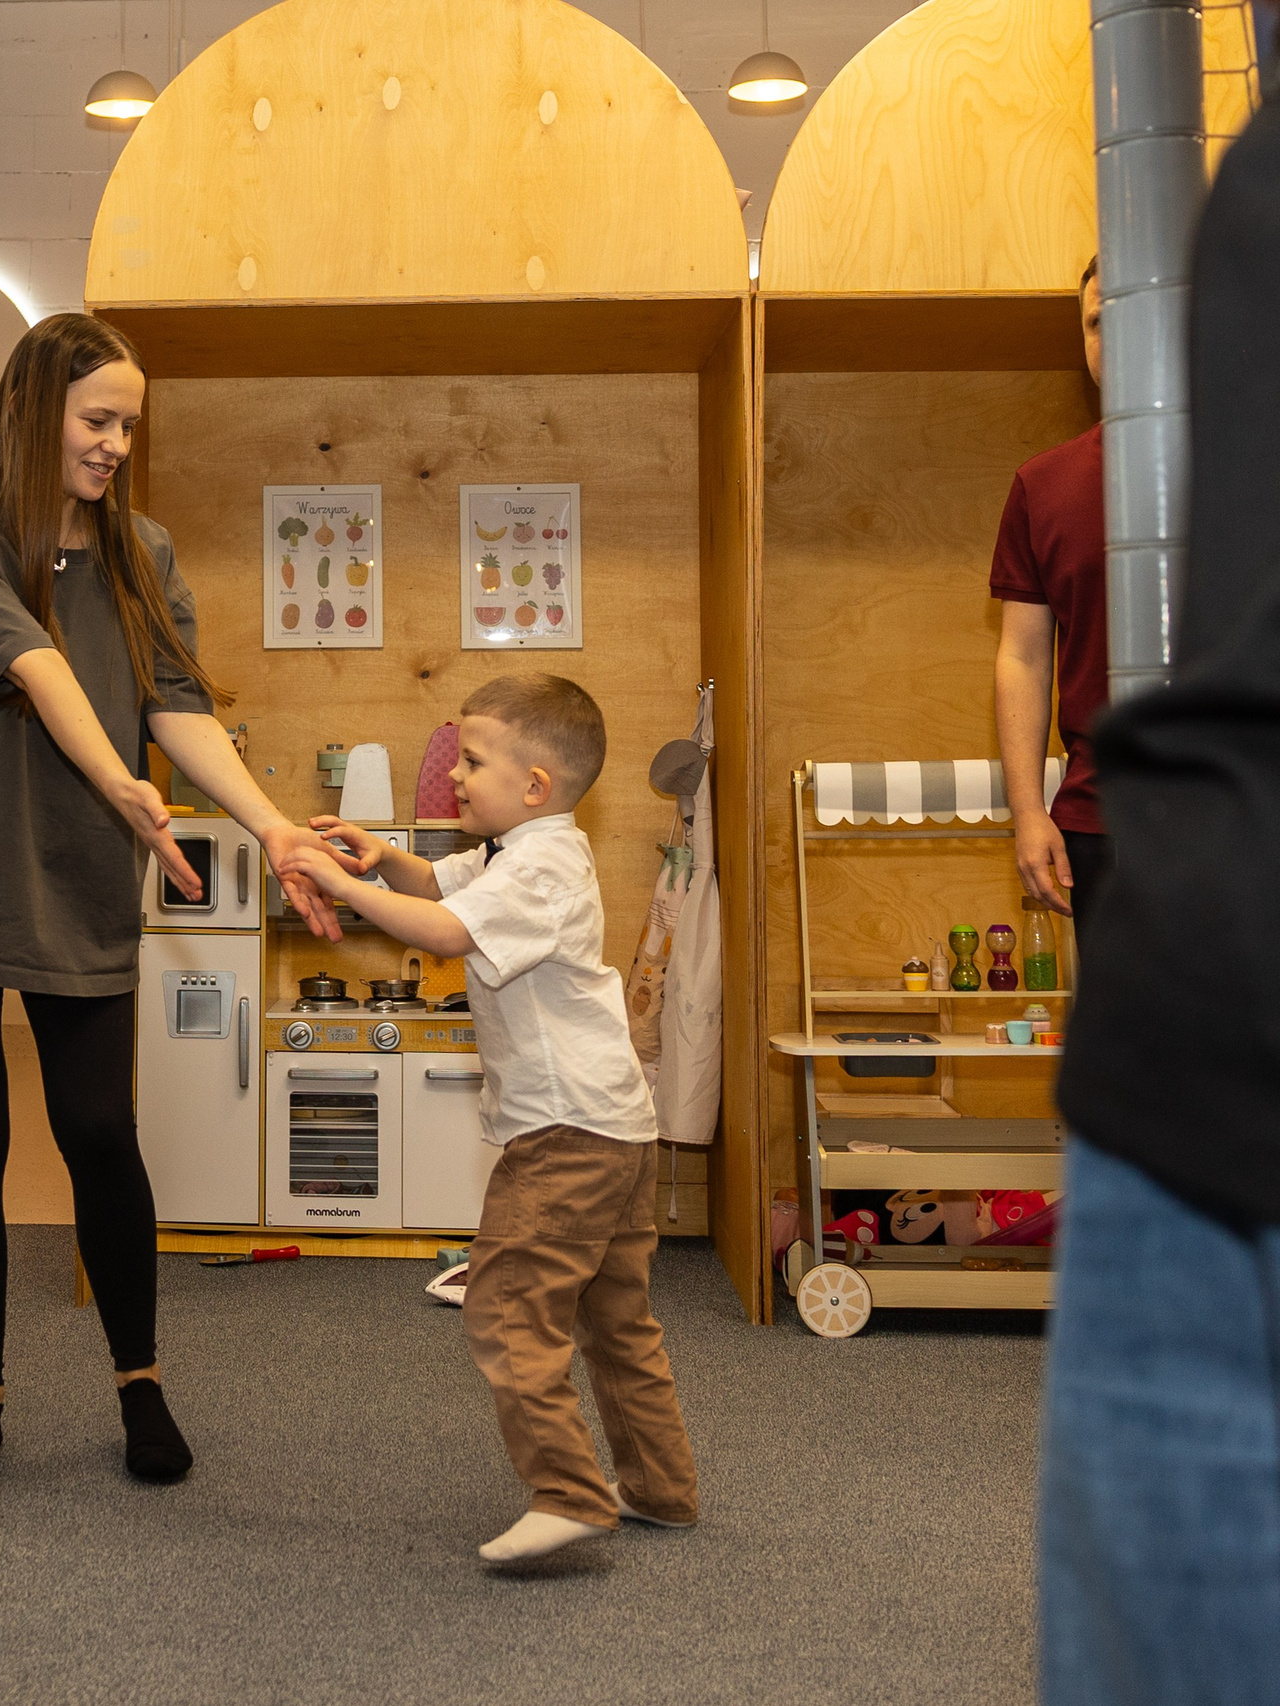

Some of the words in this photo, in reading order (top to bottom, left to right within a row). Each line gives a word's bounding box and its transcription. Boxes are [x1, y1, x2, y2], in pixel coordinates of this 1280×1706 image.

[296, 501, 350, 519] Warzywa
[504, 500, 536, 515] Owoce
[330, 1033, 353, 1041] 12:30
[306, 1206, 361, 1217] mamabrum
